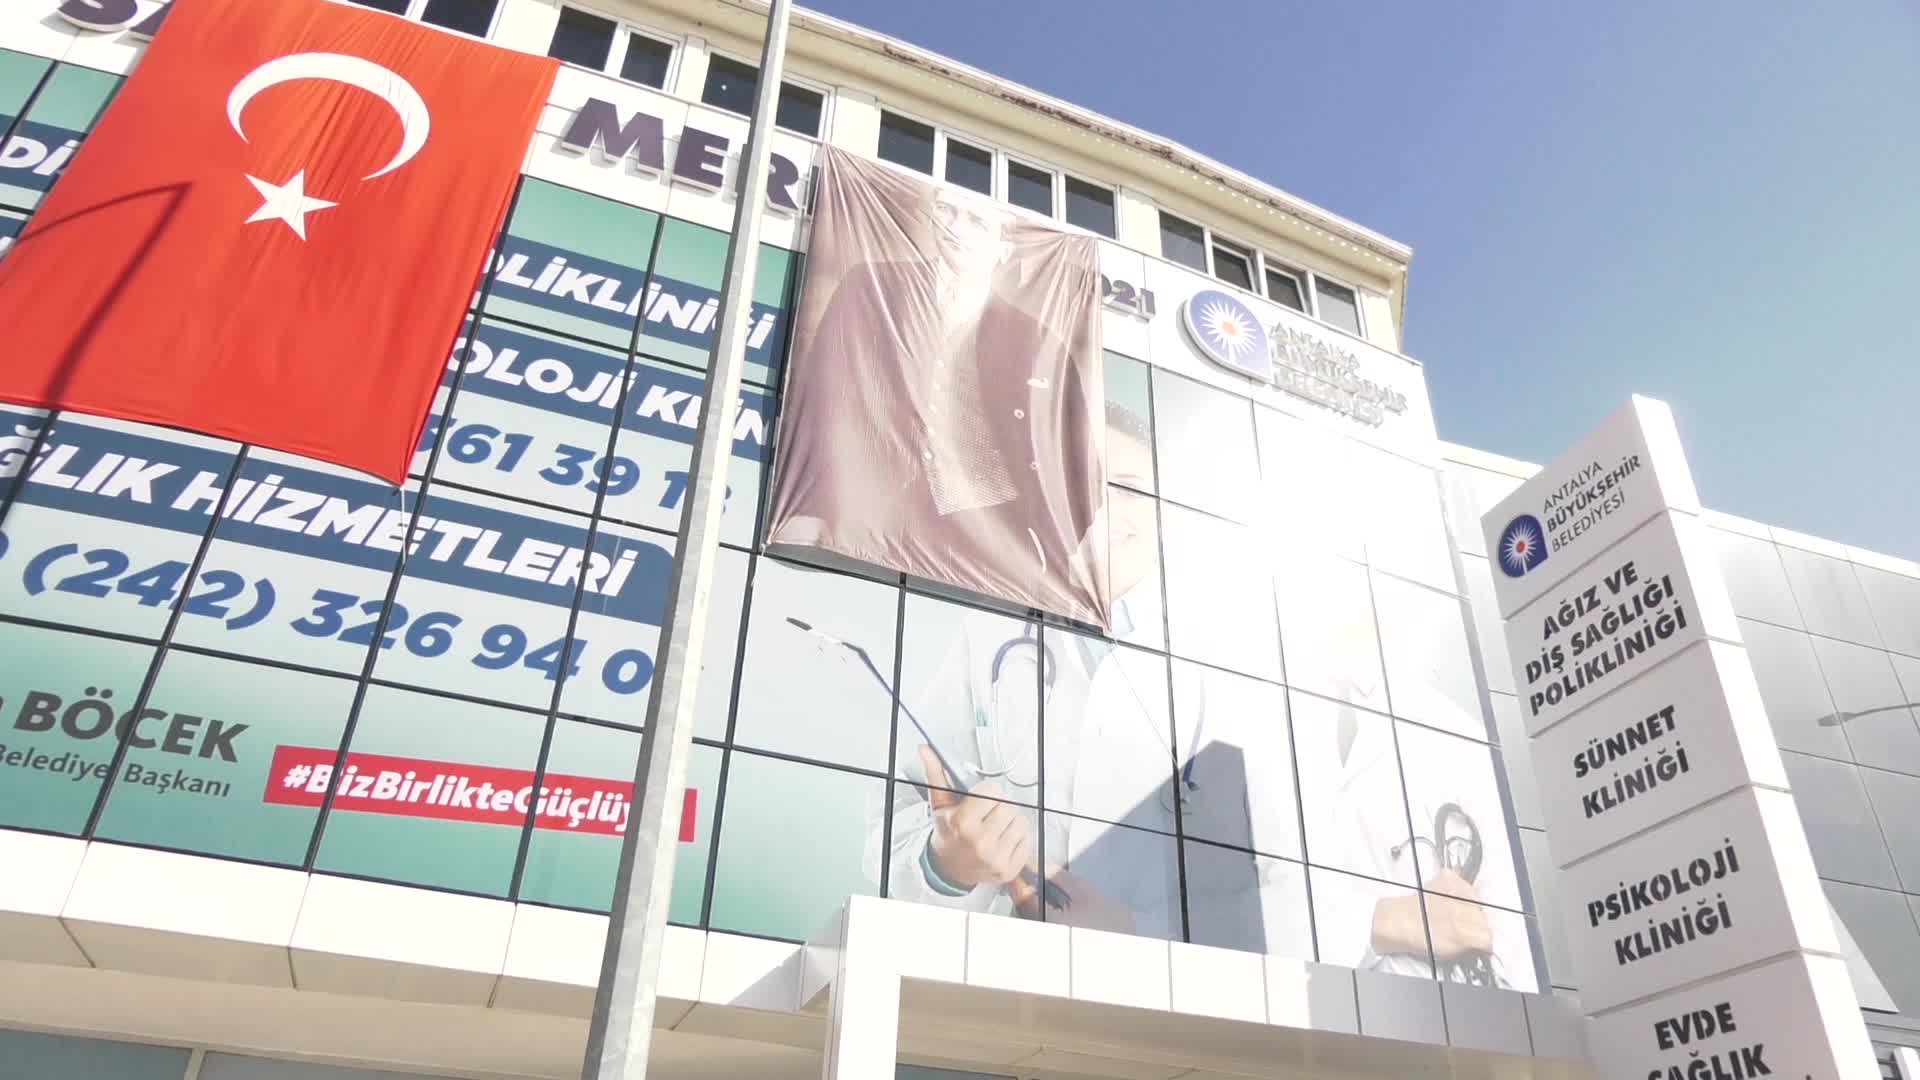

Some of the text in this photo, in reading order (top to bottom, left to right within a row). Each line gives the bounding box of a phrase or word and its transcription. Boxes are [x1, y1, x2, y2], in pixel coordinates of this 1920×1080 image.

[560, 96, 819, 216] MER
[482, 249, 776, 350] LİKLİNİİ
[636, 384, 768, 447] KLN
[538, 443, 641, 497] 39
[1543, 460, 1603, 514] ANTALYA
[1546, 455, 1641, 533] BÜYÜKŞEHİR
[171, 473, 640, 597] HİZMETLERİ
[1551, 489, 1626, 553] BELEDİYESİ
[22, 542, 276, 631] (242)
[290, 587, 463, 658] 326
[471, 623, 588, 684] 94
[1525, 573, 1675, 684] DİŞ SAĞLIĞI
[1543, 560, 1639, 641] AĞIZ VE
[1529, 599, 1688, 717] POLİKLİNİĞİ
[13, 686, 250, 763] BÖCEK
[1573, 704, 1676, 778] SÜNNET
[123, 763, 231, 797] Başkanı
[1582, 741, 1690, 819] KLİNİĞİ
[1588, 837, 1740, 927] PSİKOLOJİ
[1614, 892, 1732, 966] KLİNİĞİ
[1653, 1001, 1737, 1051] EVDE
